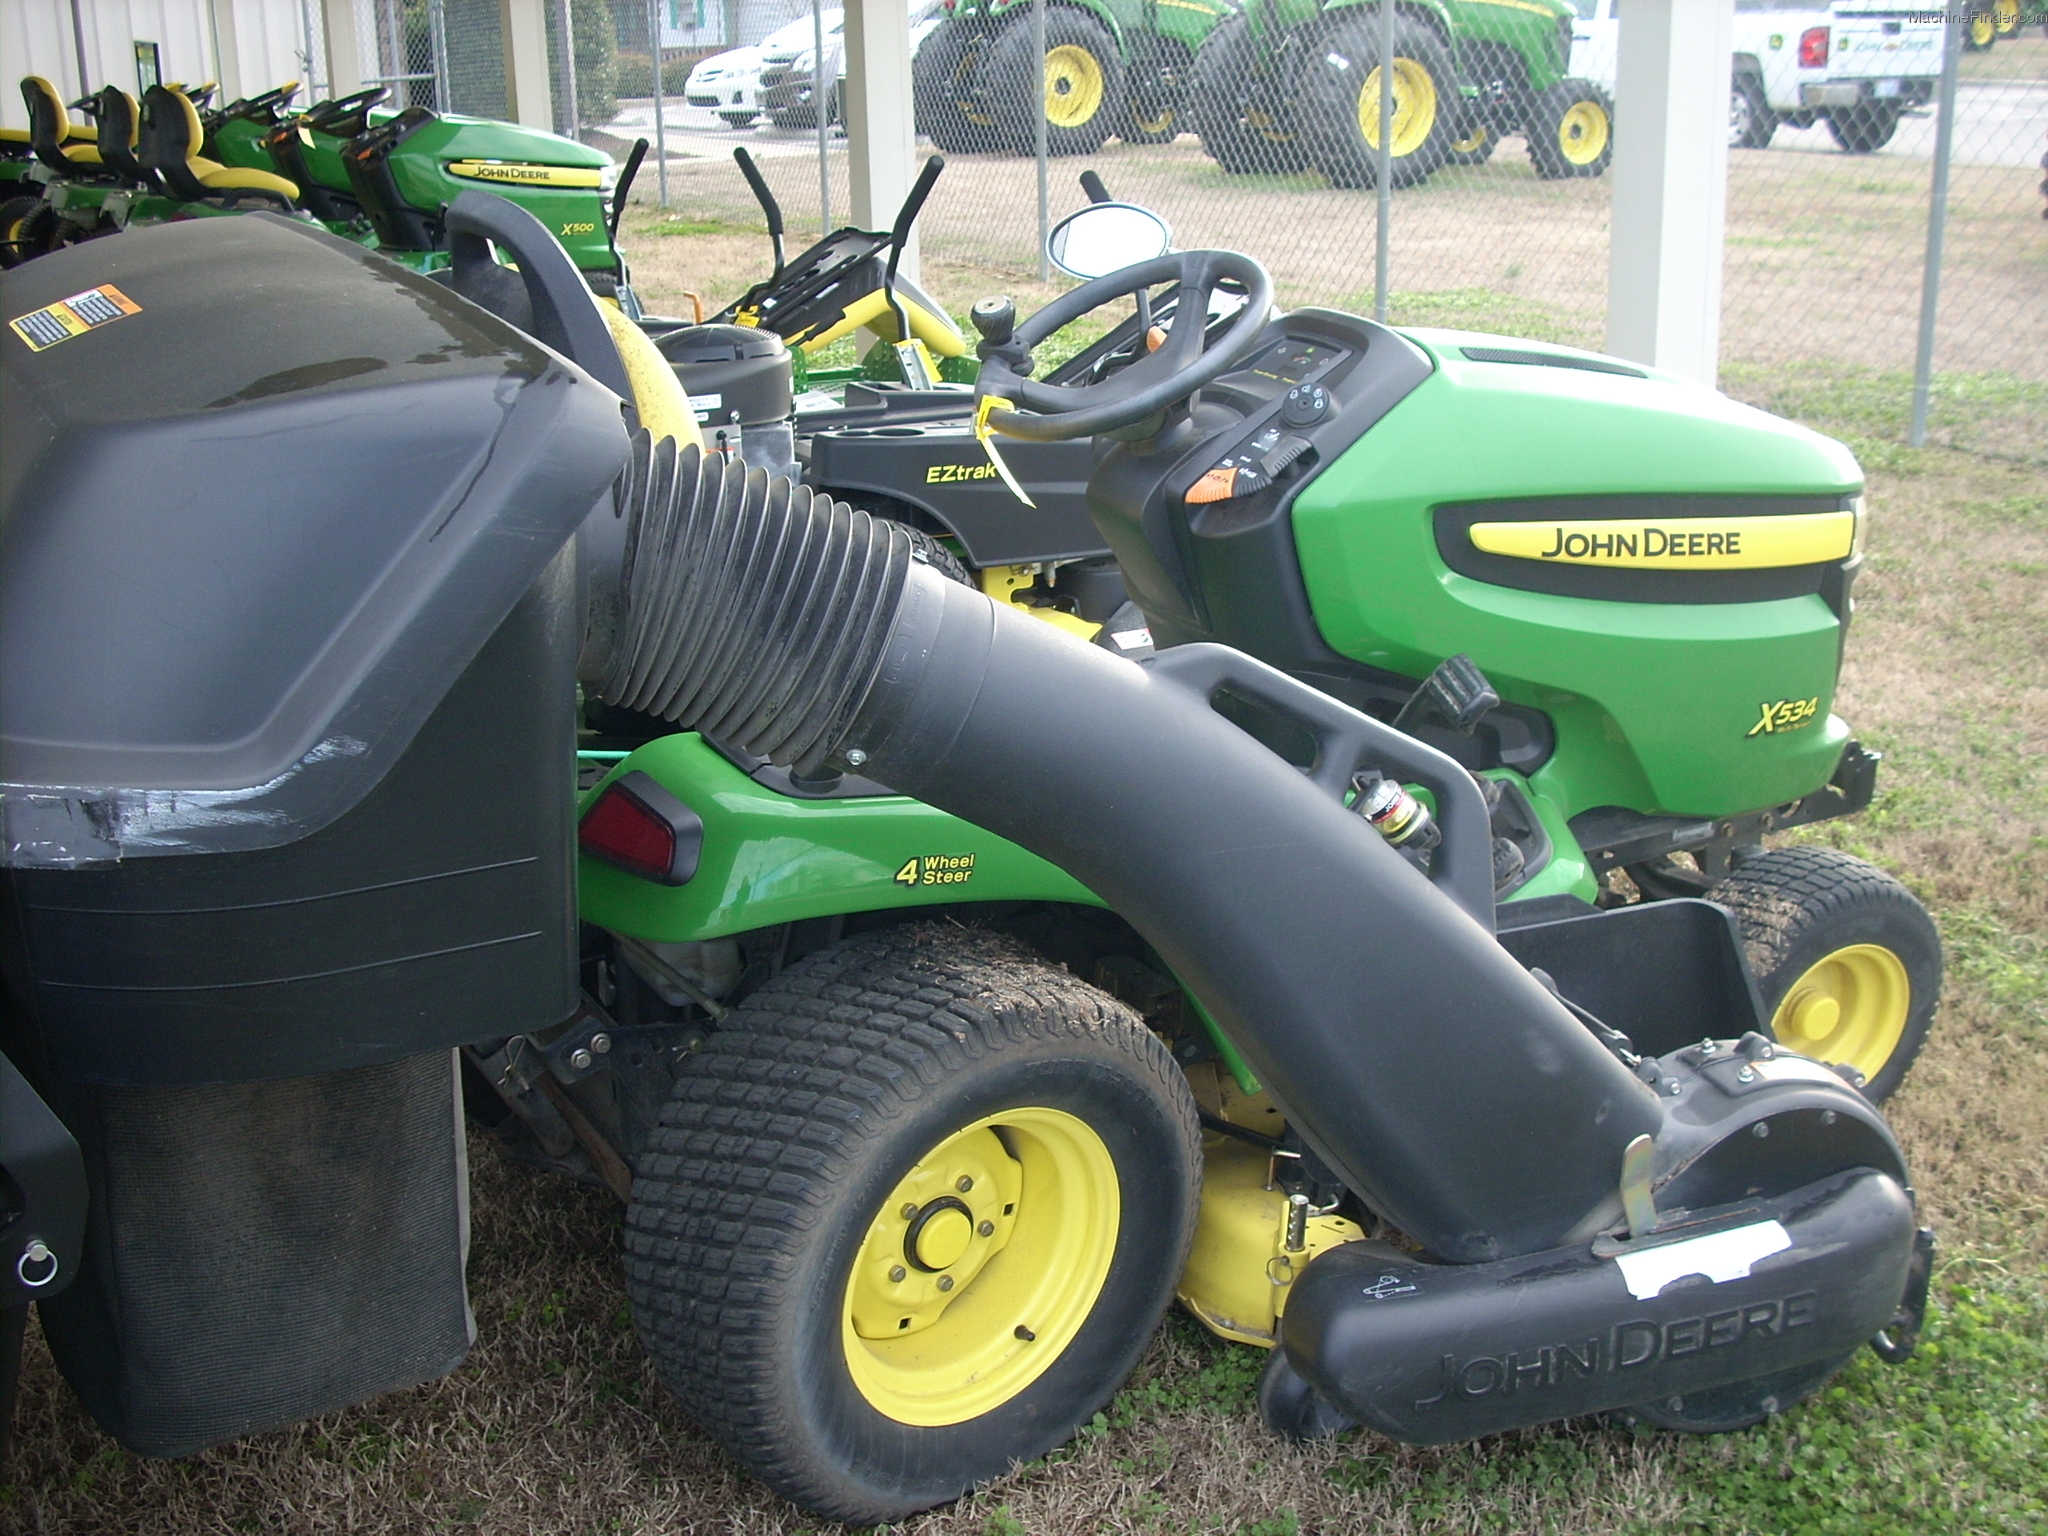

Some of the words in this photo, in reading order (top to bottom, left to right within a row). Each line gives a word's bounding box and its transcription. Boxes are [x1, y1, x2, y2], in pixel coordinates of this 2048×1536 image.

[473, 166, 509, 178] JOHN
[510, 168, 551, 180] DEERE
[560, 222, 595, 236] X500
[926, 461, 997, 484] EZtrak
[1541, 527, 1638, 558] JOHN
[1643, 527, 1741, 557] DEERE
[1747, 696, 1819, 736] X534
[896, 858, 919, 885] 4
[924, 853, 975, 870] Wheel
[922, 870, 972, 885] Steer
[1414, 1336, 1600, 1412] JOHN
[1608, 1289, 1818, 1373] DEERE
